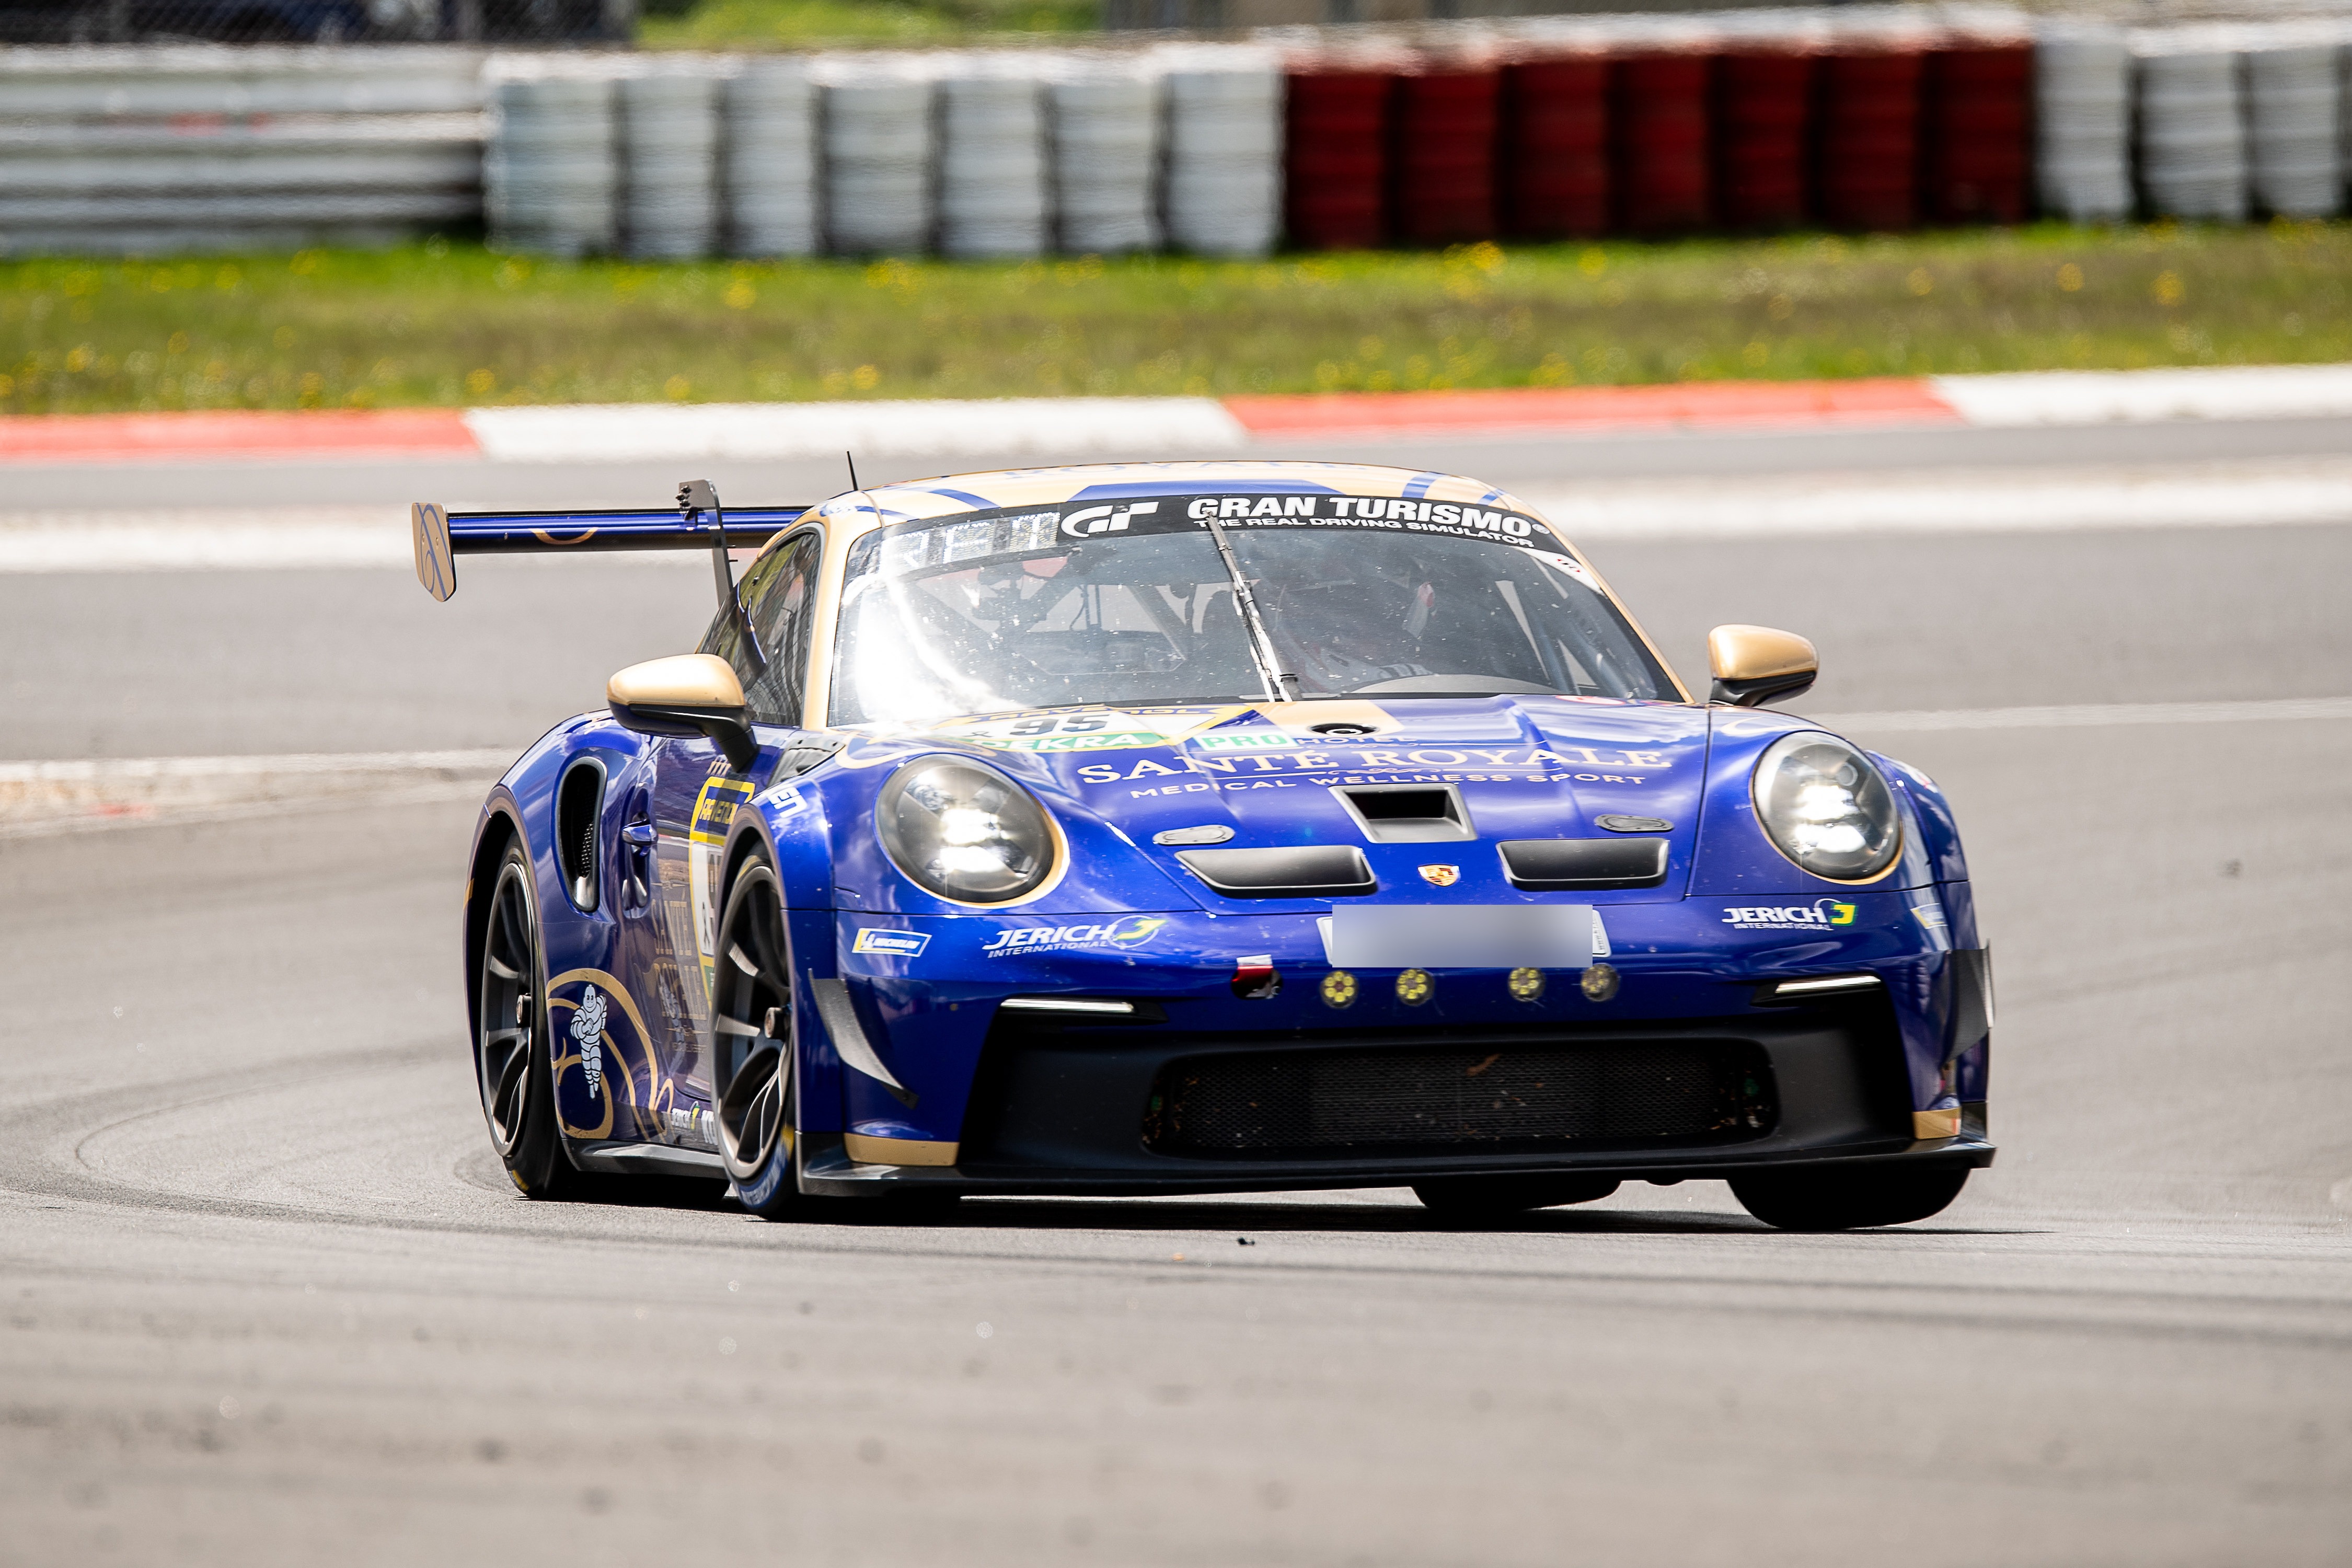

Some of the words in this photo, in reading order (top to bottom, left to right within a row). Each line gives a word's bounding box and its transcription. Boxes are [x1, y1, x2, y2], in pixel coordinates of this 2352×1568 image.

[1187, 497, 1317, 520] GRAN
[1308, 517, 1403, 529] DRIVING
[1406, 522, 1535, 547] SIMULATOR
[1009, 713, 1111, 736] 95
[972, 734, 1143, 750] DEKRA
[1201, 735, 1289, 748] PRO
[1297, 736, 1418, 745] HOTEL
[1077, 749, 1340, 784] SANTÉ
[1351, 747, 1673, 768] ROYALE
[1129, 777, 1297, 799] MEDICAL
[1308, 774, 1519, 785] WELLNESS
[1525, 773, 1646, 785] SPORT
[1722, 907, 1828, 923] JERICH
[982, 924, 1119, 950] JERICH
[987, 940, 1109, 958] INTERNATIONAL
